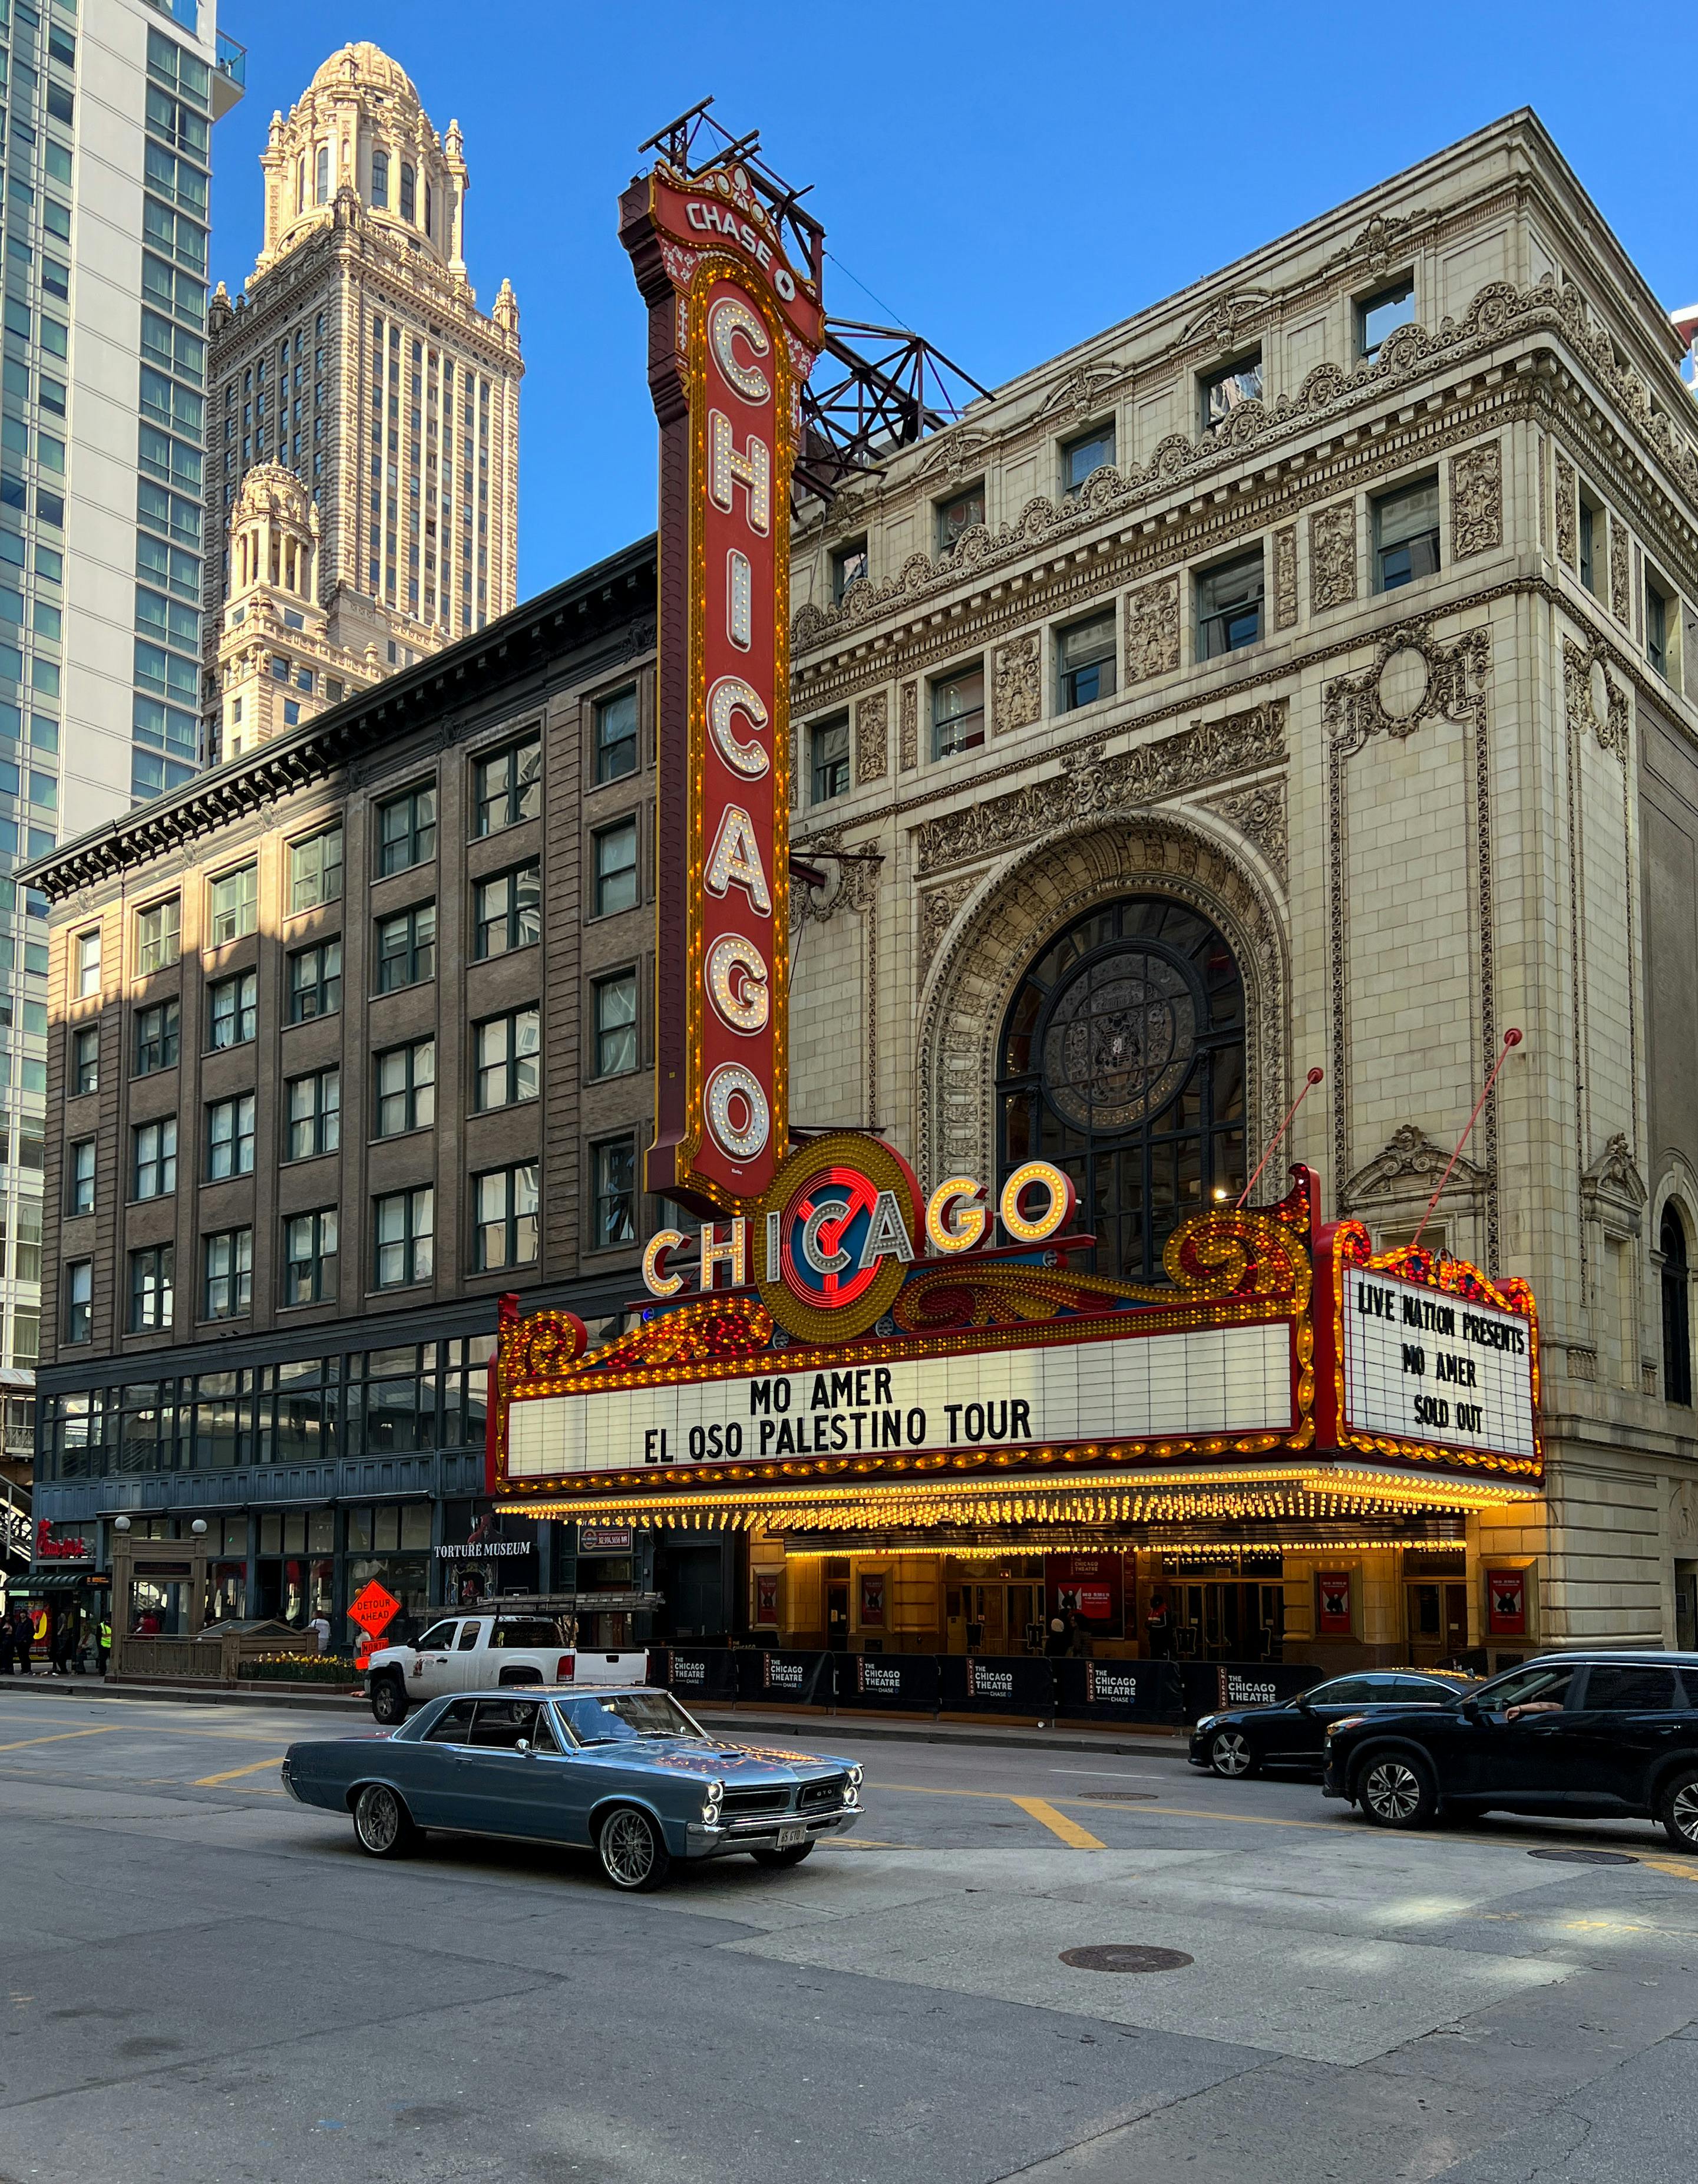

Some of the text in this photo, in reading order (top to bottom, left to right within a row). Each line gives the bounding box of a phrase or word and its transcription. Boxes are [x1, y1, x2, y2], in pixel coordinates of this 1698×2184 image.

[685, 203, 773, 271] CHASE
[704, 297, 772, 1164] CHICAGO
[642, 1160, 1072, 1297] CHICAGO
[1358, 1282, 1525, 1355] LIVE NATION PRESENTS
[1402, 1343, 1477, 1388] MO AMER
[751, 1367, 893, 1416] MO AMER
[1415, 1394, 1483, 1434] SOLD OUT
[645, 1399, 1032, 1463] EL OSO PALESTINO TOUR
[434, 1542, 530, 1558] TORTURE MUSEUM
[357, 1599, 391, 1610] DETOUR
[361, 1611, 389, 1621] AHEAD
[771, 1665, 803, 1674] CHICAGO
[864, 1670, 900, 1678] CHICAGO
[975, 1672, 1012, 1681] CHICAGO
[1095, 1677, 1136, 1686] CHICAGO
[976, 1681, 1012, 1690] THEATRE
[1096, 1686, 1136, 1695] THEATRE
[1228, 1682, 1276, 1693] CHICAGO
[1229, 1692, 1276, 1702] THEATRE
[781, 1829, 801, 1842] 65 GTO
